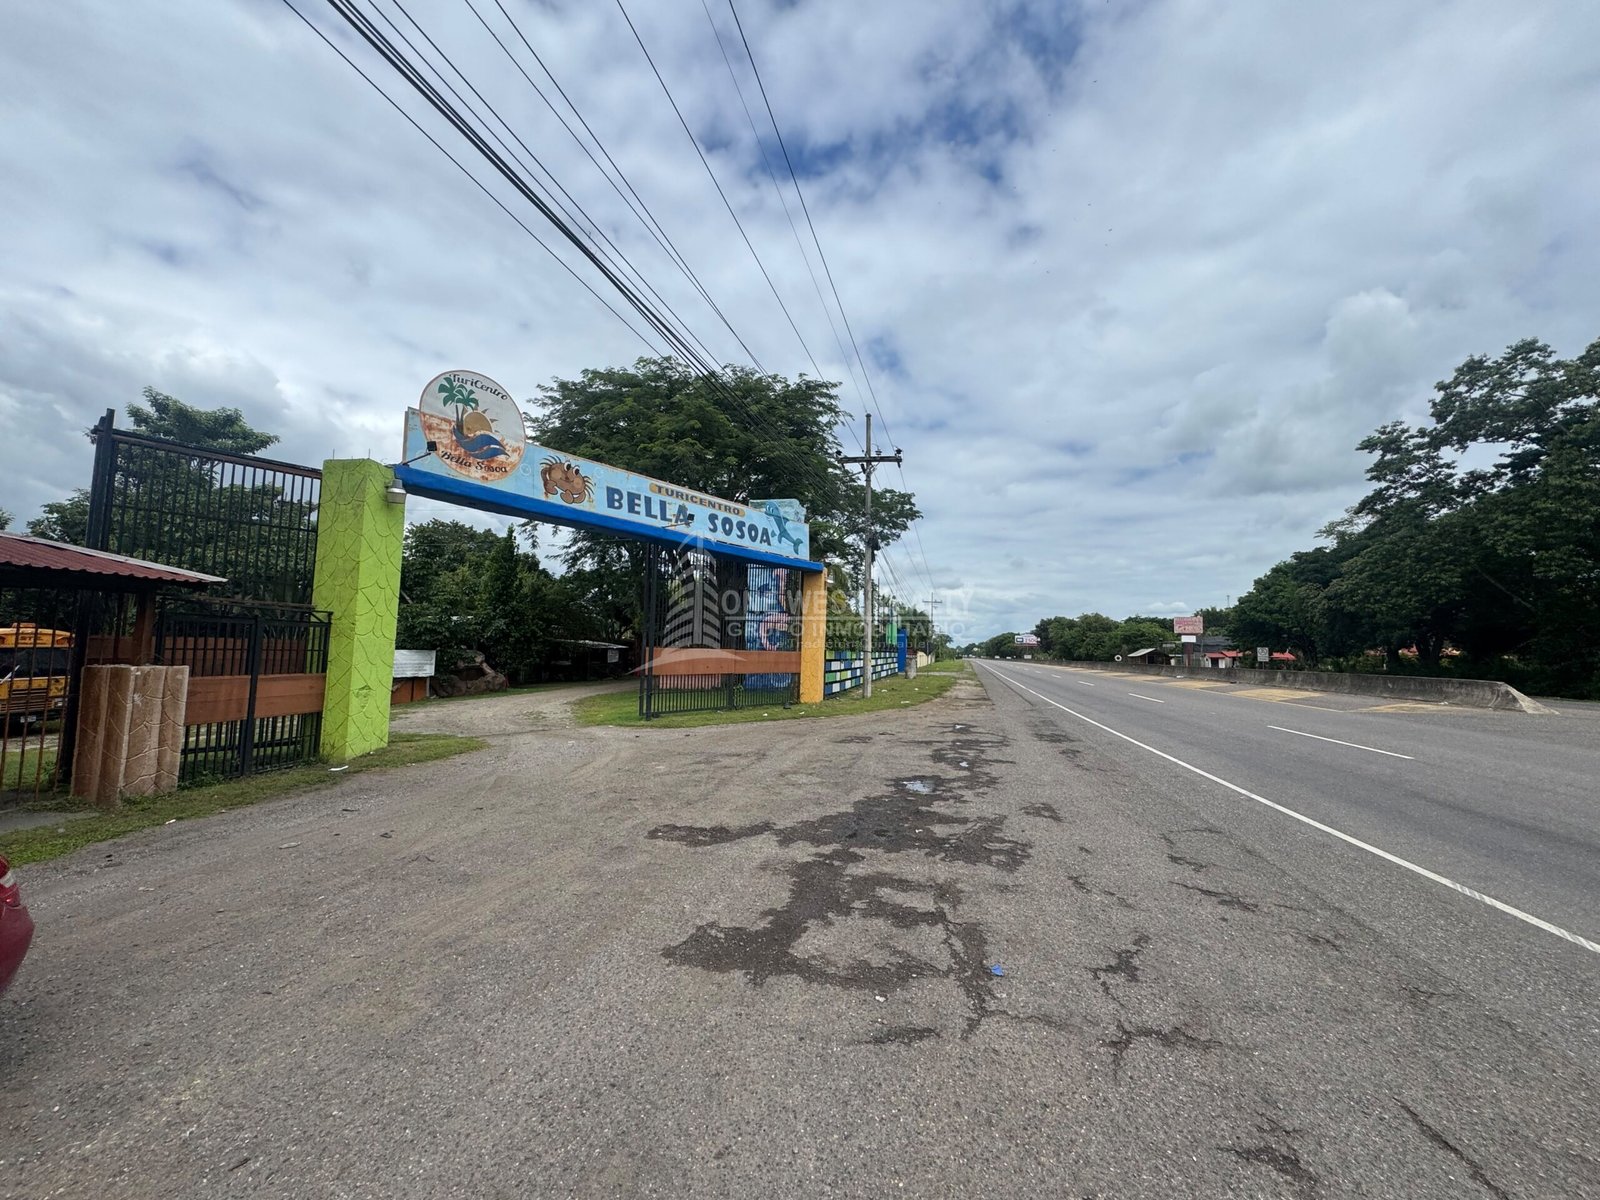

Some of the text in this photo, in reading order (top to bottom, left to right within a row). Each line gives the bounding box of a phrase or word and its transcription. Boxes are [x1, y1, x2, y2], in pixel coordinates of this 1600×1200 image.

[449, 373, 508, 401] TuriCentro
[441, 450, 472, 468] Bella
[656, 485, 740, 516] TURICENTRO
[606, 486, 772, 547] BELLA SOSOA
